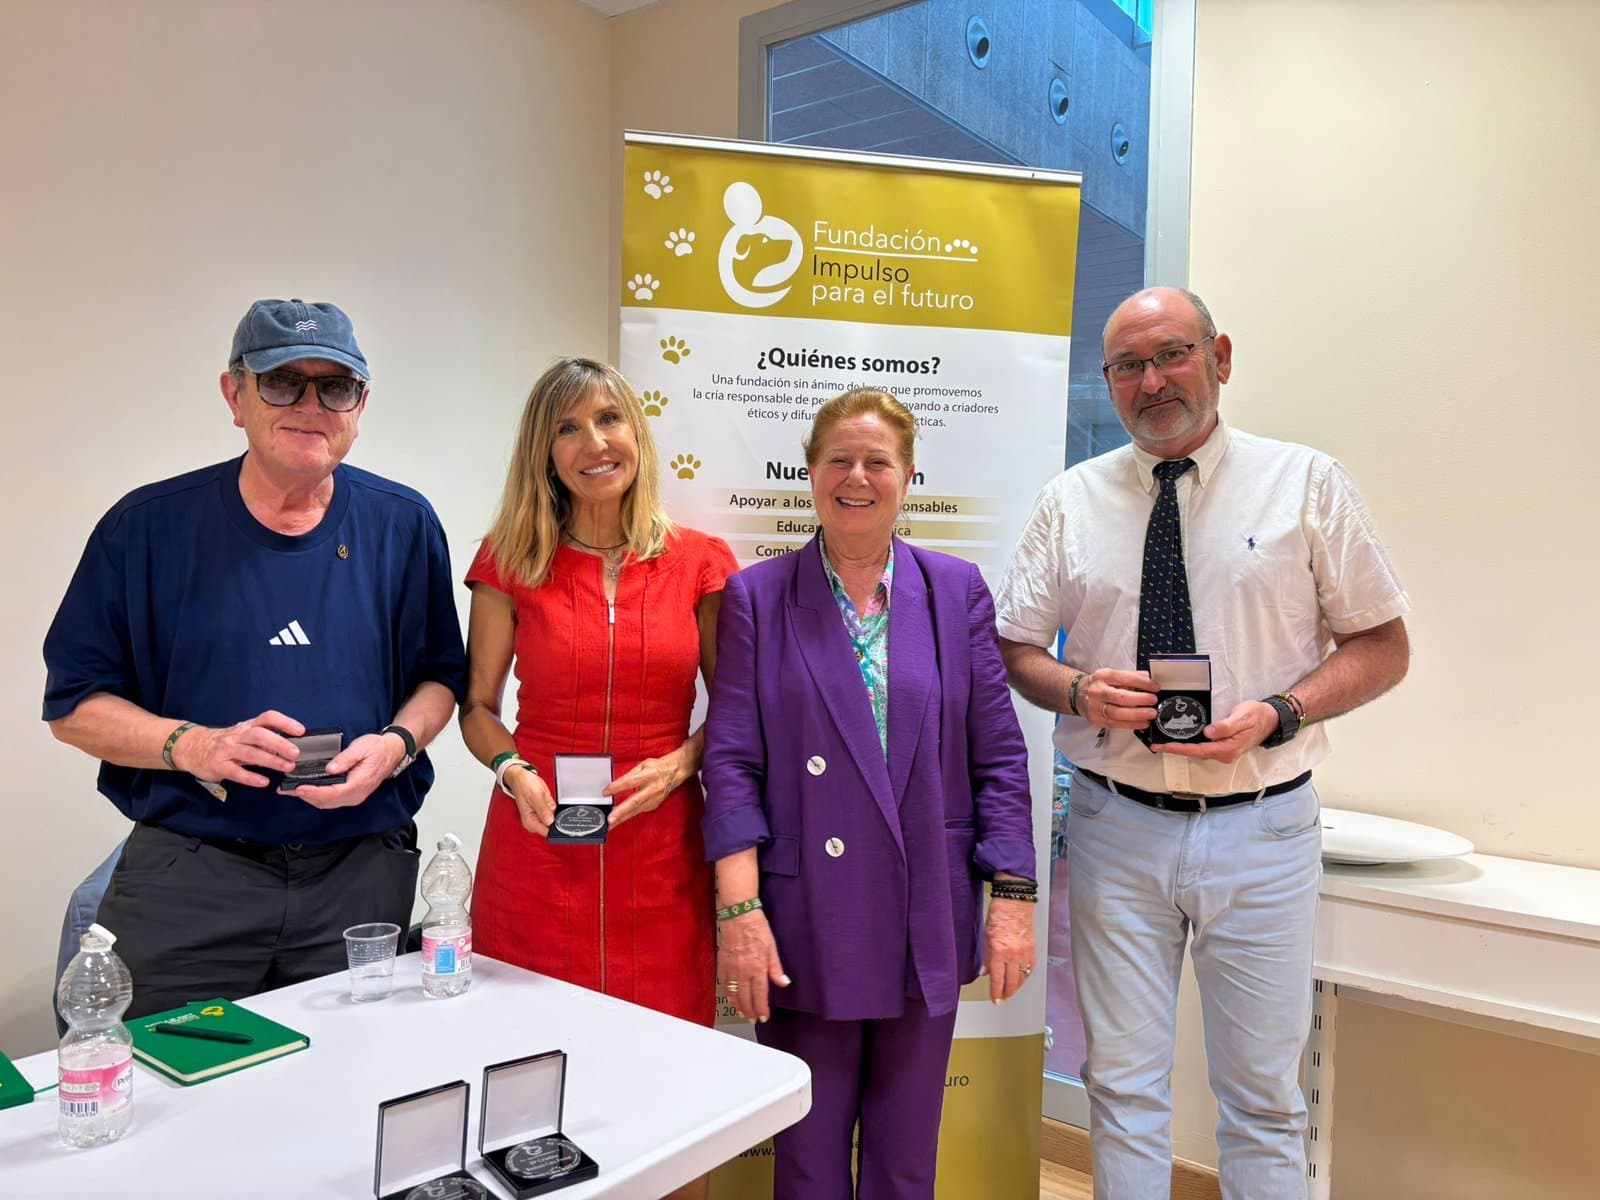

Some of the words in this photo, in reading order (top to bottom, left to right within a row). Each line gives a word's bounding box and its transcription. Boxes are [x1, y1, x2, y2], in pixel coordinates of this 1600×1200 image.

[813, 220, 941, 252] Fundación
[812, 254, 909, 285] Impulso
[811, 284, 865, 307] para
[873, 283, 894, 306] el
[901, 283, 974, 311] futuro
[757, 347, 857, 370] ¿Quiénes
[861, 356, 941, 375] somos?
[712, 374, 733, 385] Una
[736, 375, 791, 389] fundación
[793, 379, 809, 389] sin
[811, 379, 844, 391] ánimo
[890, 385, 911, 397] que
[913, 387, 982, 398] promovemos
[693, 388, 702, 400] la
[704, 390, 725, 401] cría
[727, 392, 793, 405] responsable
[795, 394, 809, 404] de
[943, 404, 950, 412] a
[952, 403, 999, 414] criadores
[747, 407, 780, 419] éticos
[782, 411, 788, 422] y
[766, 461, 809, 480] Nue
[729, 494, 777, 509] Apoyar
[783, 498, 790, 507] a
[794, 496, 812, 508] los
[902, 501, 958, 513] onsables
[776, 520, 816, 533] Educa
